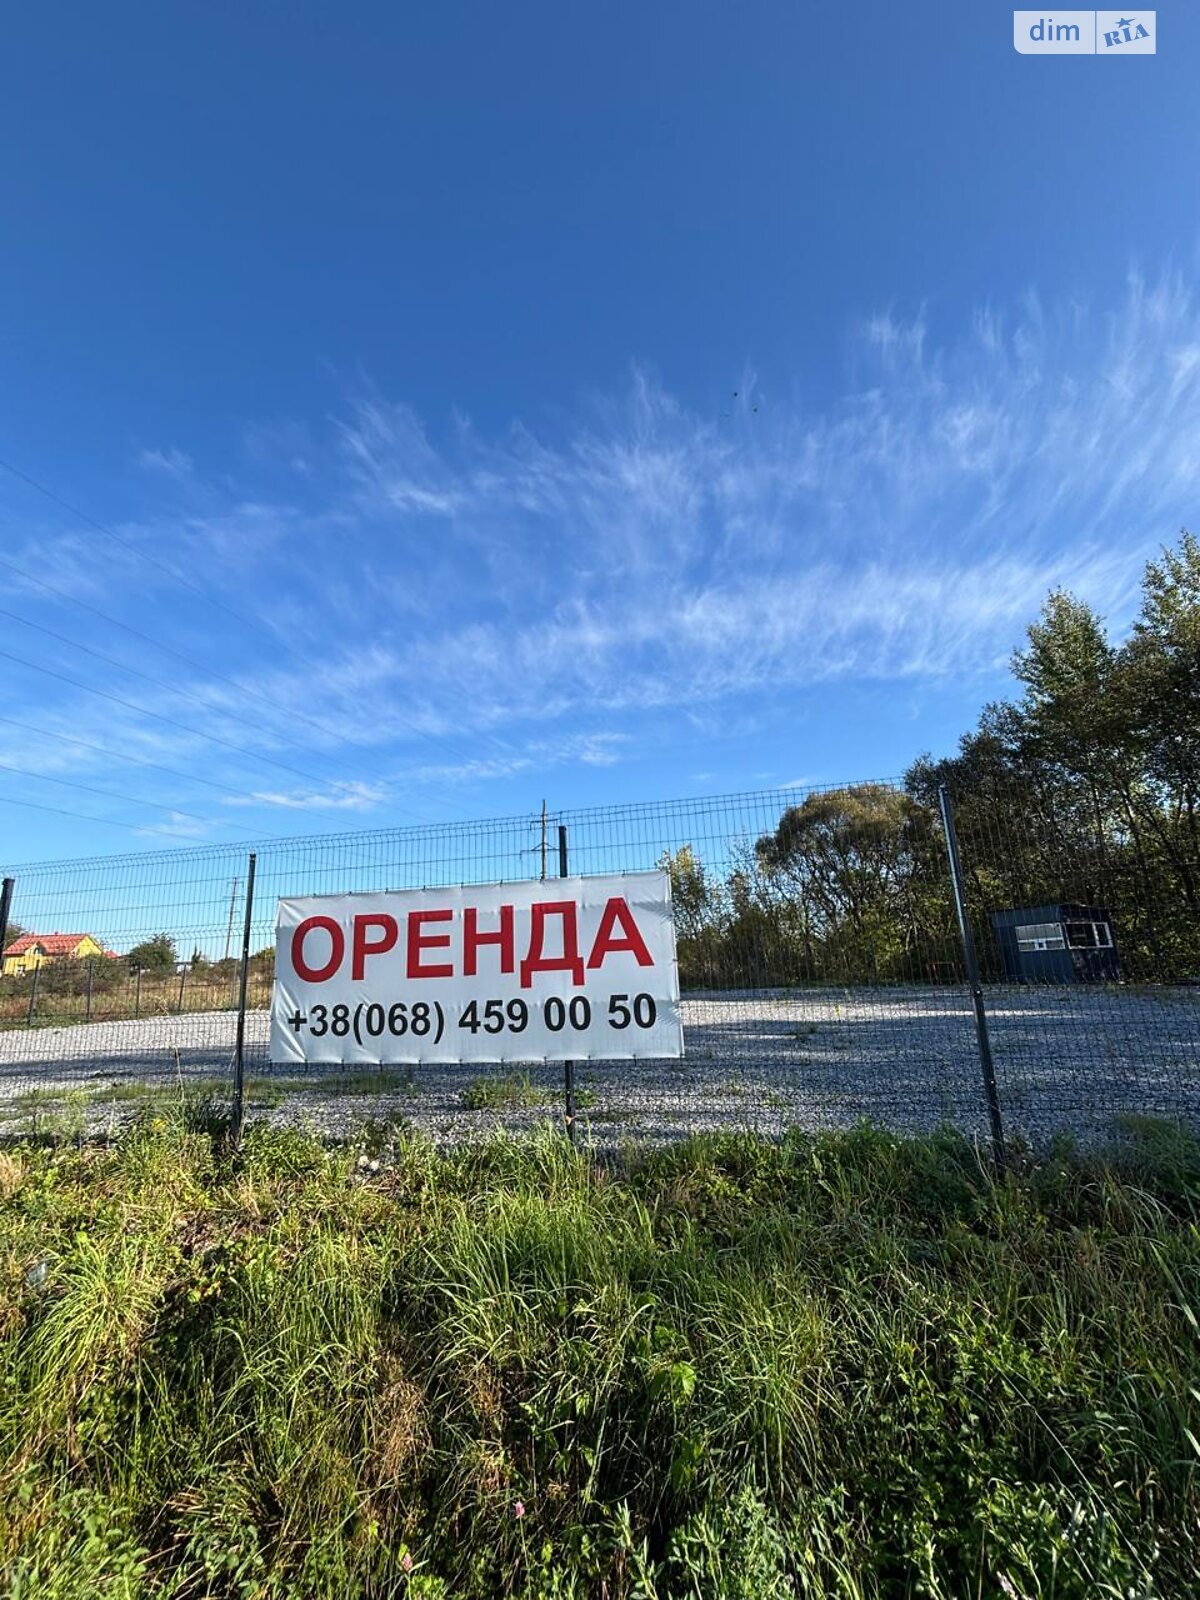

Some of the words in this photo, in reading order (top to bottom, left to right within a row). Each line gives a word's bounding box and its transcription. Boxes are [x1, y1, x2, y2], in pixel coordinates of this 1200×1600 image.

[291, 897, 655, 988] ОРЕНДА
[287, 1001, 445, 1045] +38(068)
[458, 998, 528, 1034] 459
[544, 995, 592, 1032] 00
[607, 993, 657, 1030] 50
